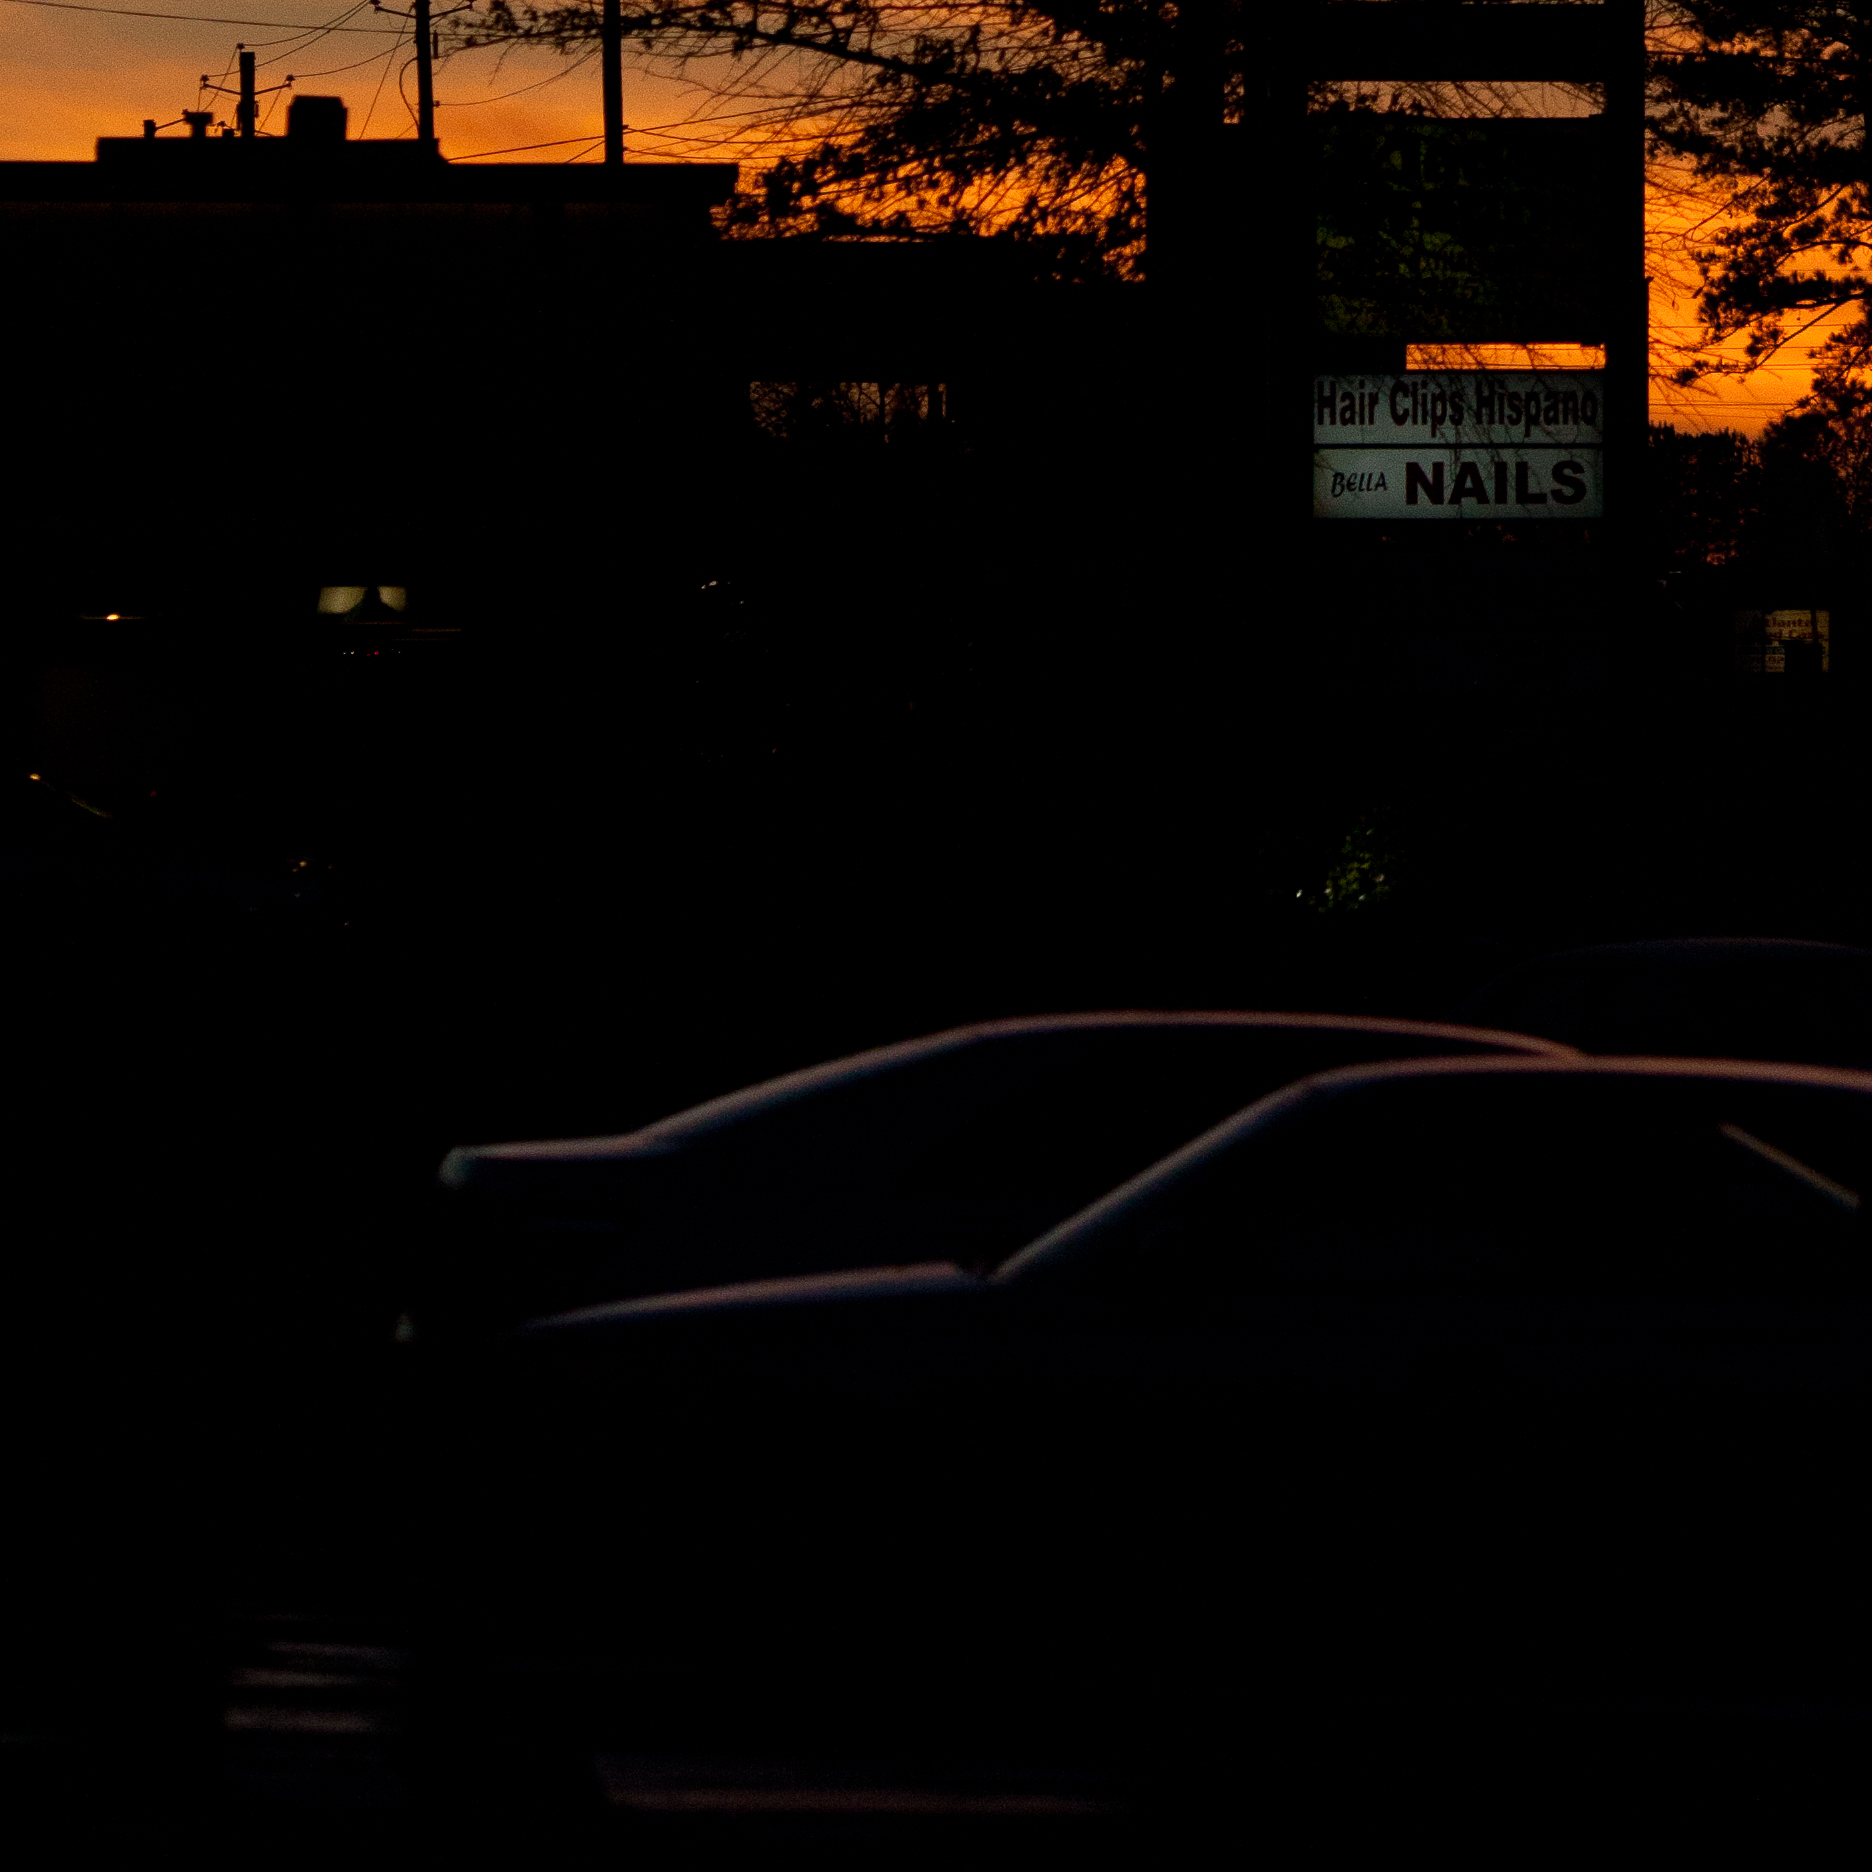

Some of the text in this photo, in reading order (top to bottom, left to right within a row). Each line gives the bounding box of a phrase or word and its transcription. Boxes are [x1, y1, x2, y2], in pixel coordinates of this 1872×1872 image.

[1316, 379, 1598, 438] Hair Clips Hispano
[1406, 459, 1587, 505] NAILS
